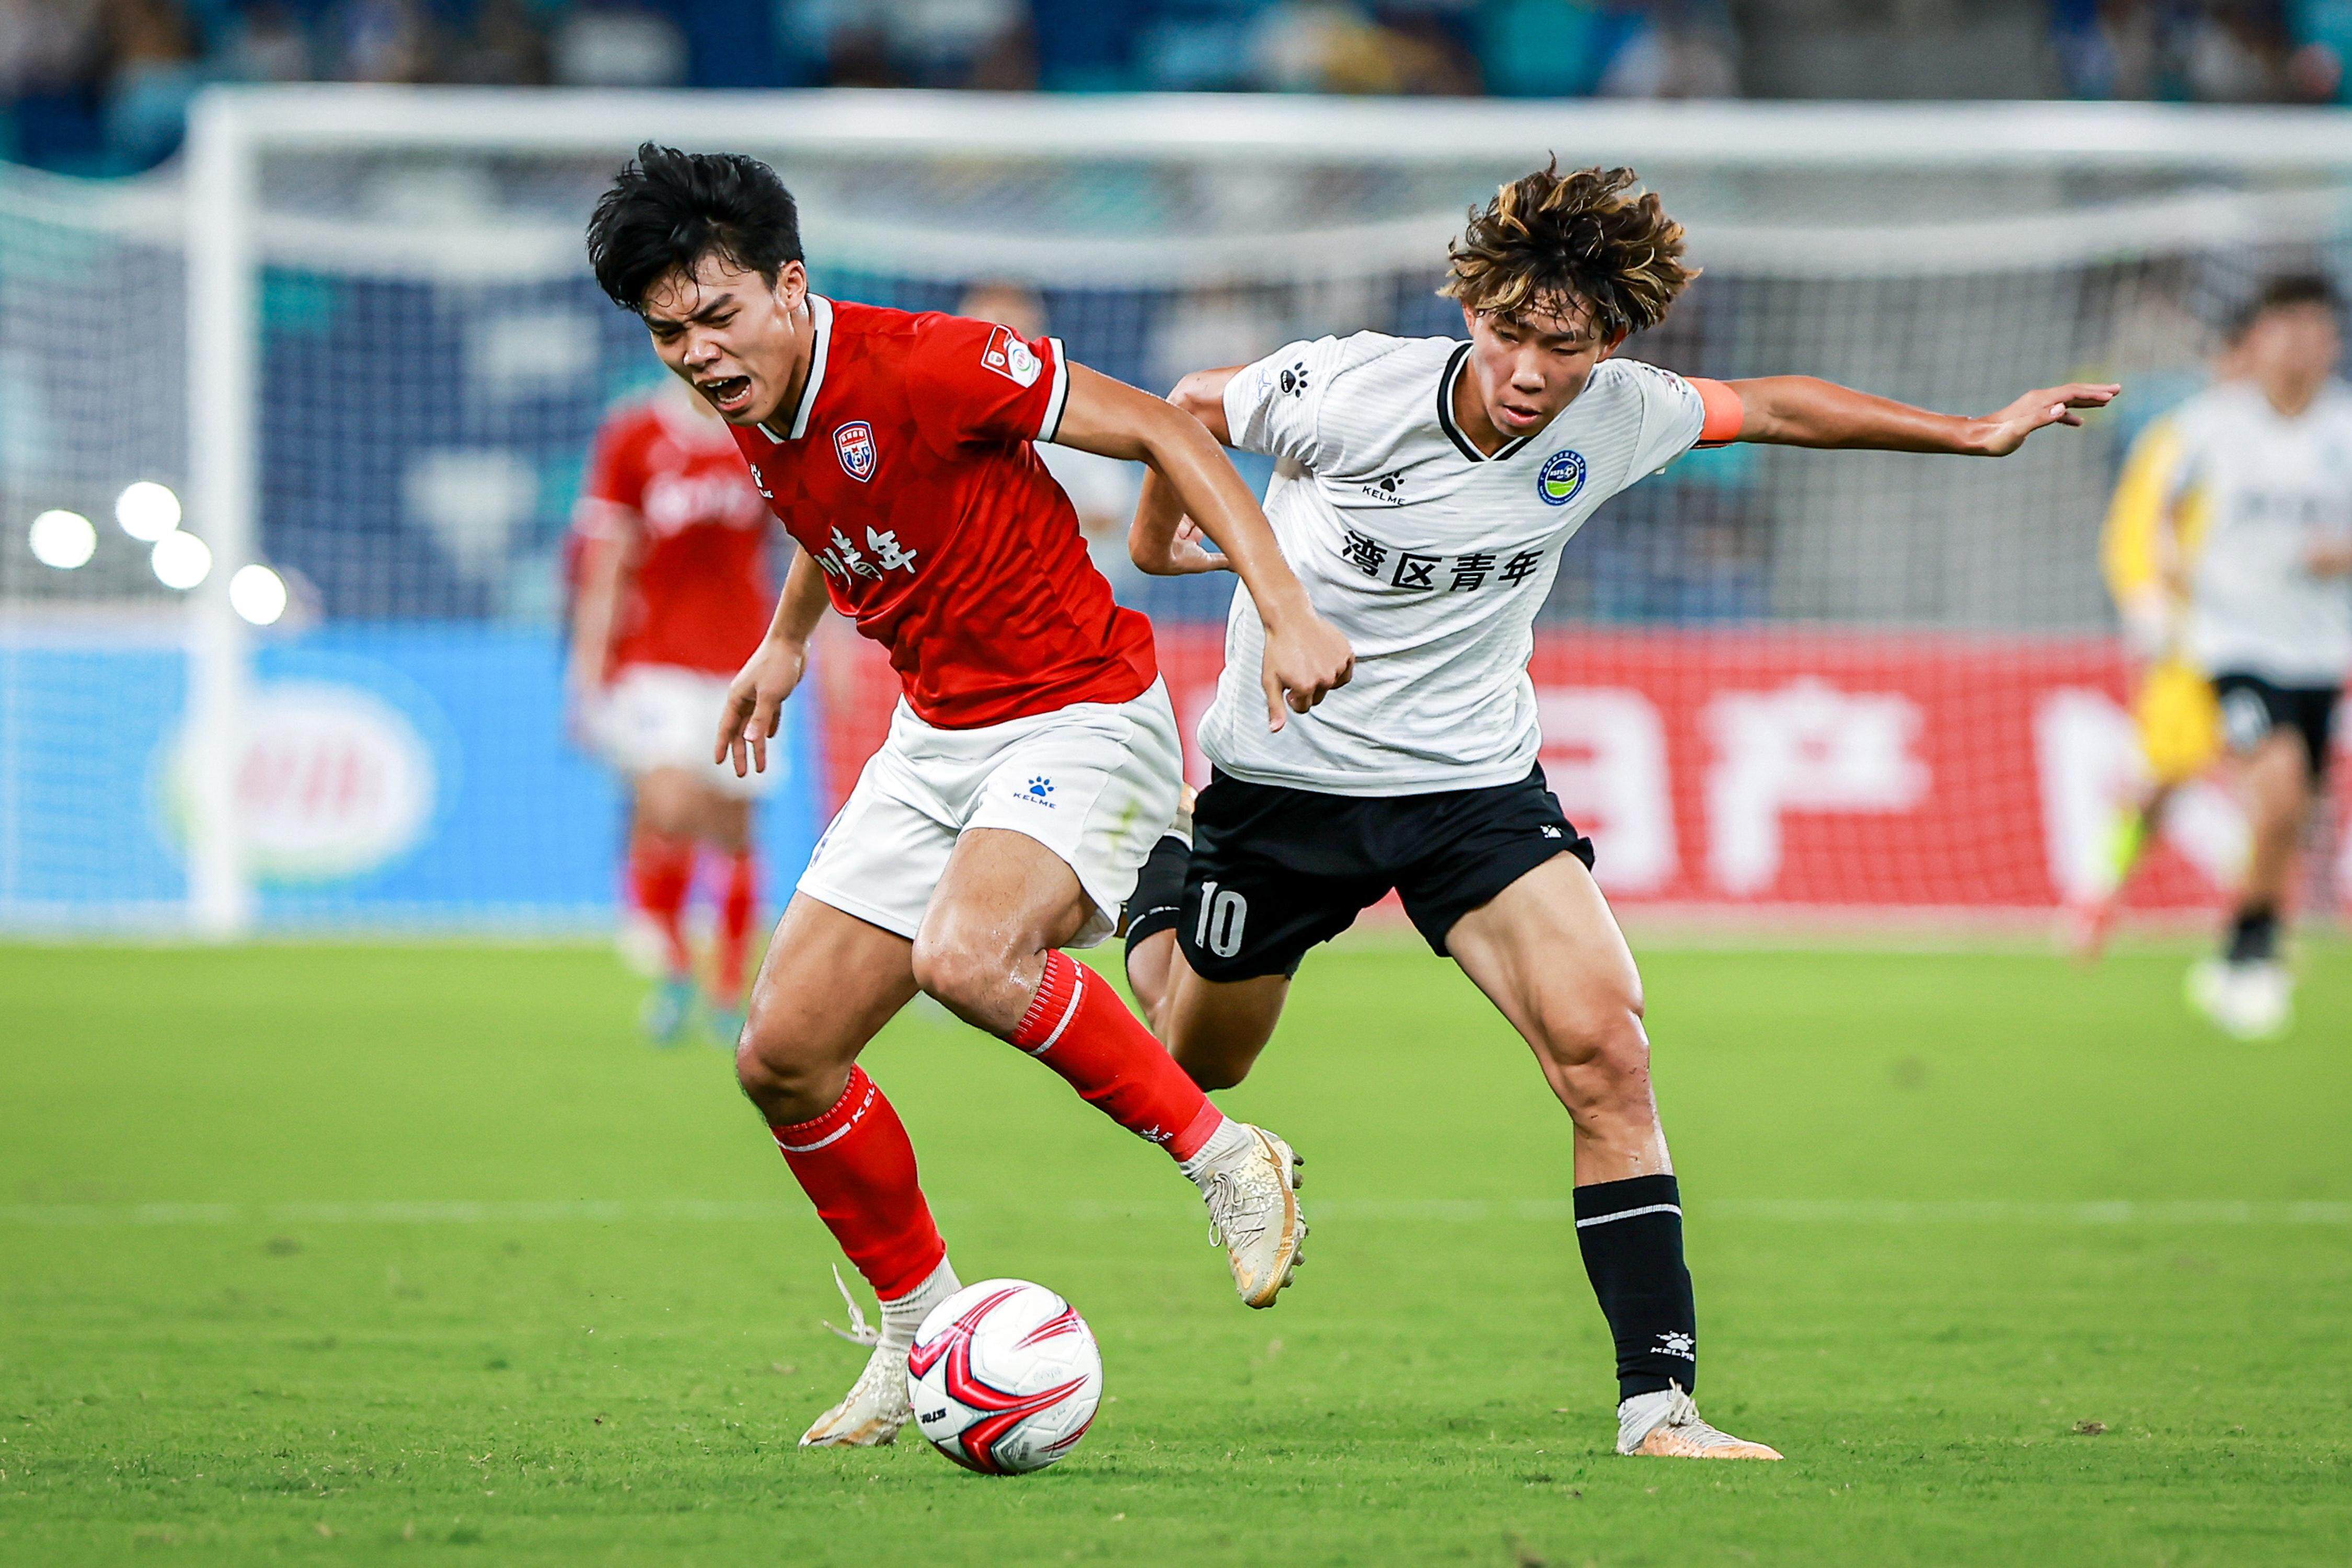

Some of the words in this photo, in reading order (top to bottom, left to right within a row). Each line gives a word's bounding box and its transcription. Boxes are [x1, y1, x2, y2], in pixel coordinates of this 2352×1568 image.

[1362, 486, 1406, 506] KELME
[1342, 531, 1544, 591] 湾区青年
[1013, 792, 1056, 809] KELME
[1195, 881, 1247, 958] 10
[851, 1078, 875, 1123] KEL
[1650, 1347, 1694, 1362] KELME
